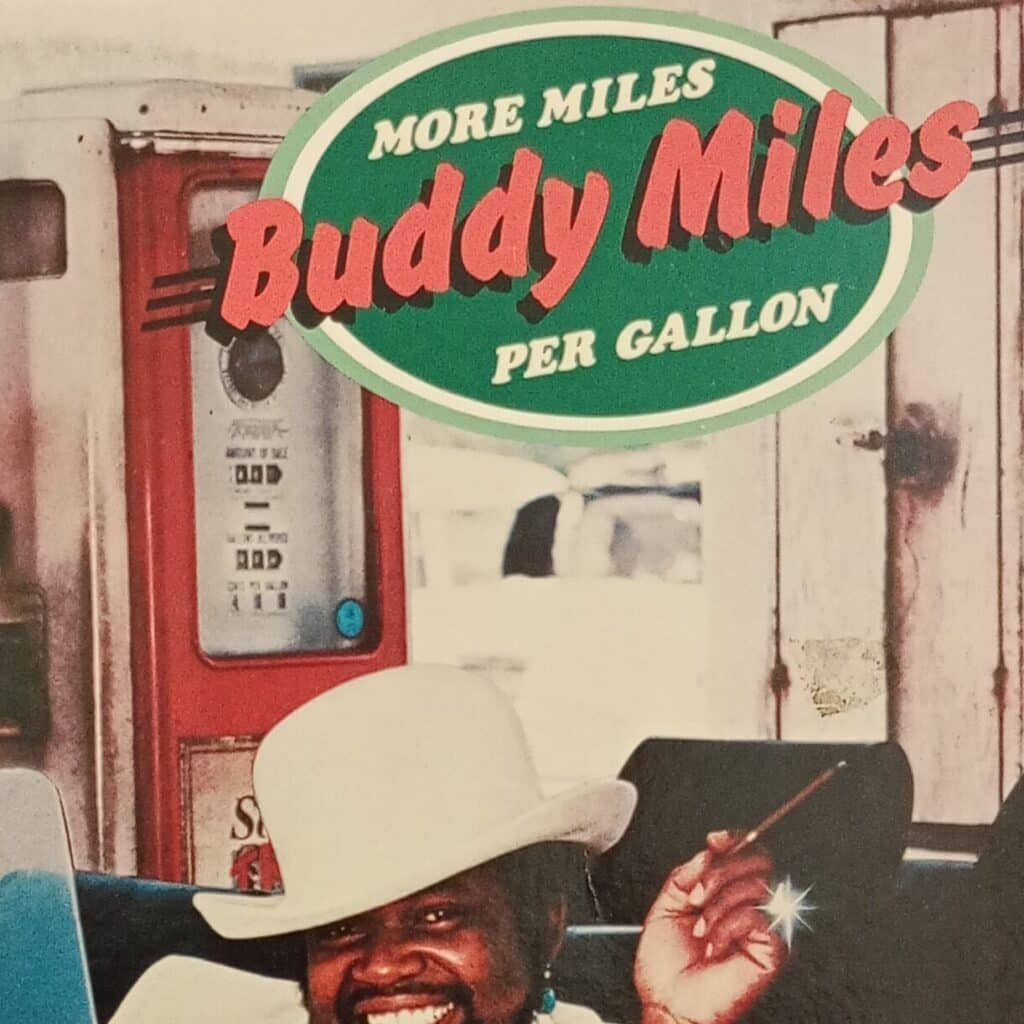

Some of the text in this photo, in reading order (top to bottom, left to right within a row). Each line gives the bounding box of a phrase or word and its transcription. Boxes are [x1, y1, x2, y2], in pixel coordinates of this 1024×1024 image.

[367, 58, 717, 161] MORE MILES
[216, 90, 980, 333] Buddy Miles
[491, 283, 839, 386] PER GALLON
